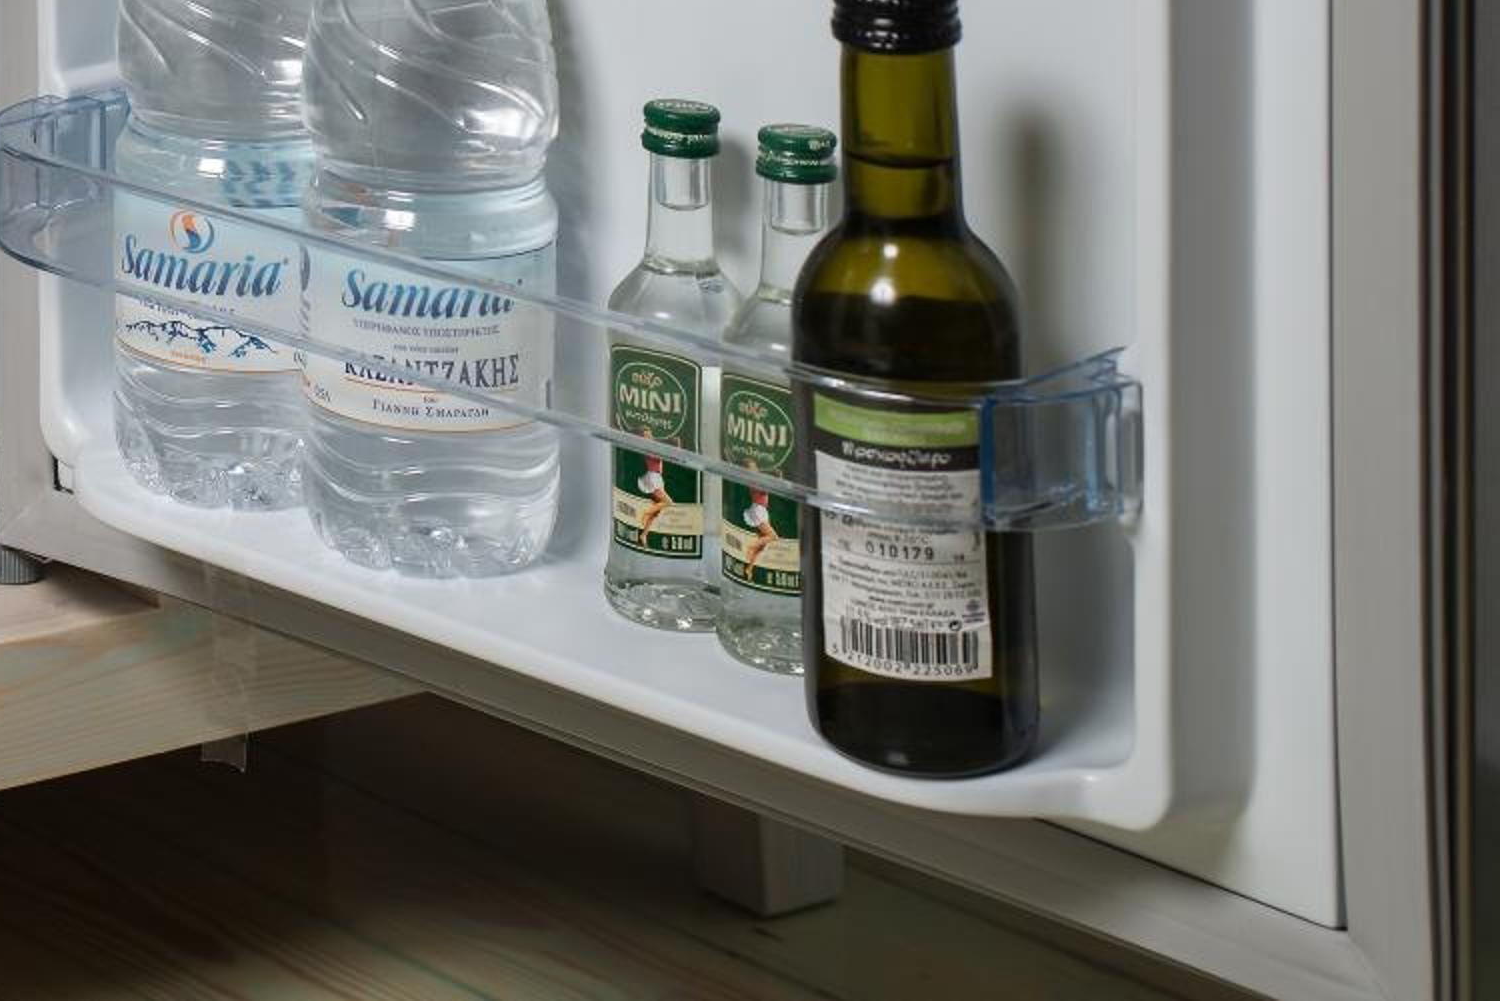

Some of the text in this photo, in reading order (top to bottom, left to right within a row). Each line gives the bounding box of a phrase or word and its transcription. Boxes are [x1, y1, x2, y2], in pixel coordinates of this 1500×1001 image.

[121, 234, 281, 298] Samaria
[619, 383, 682, 414] MINI
[727, 413, 787, 447] MINI
